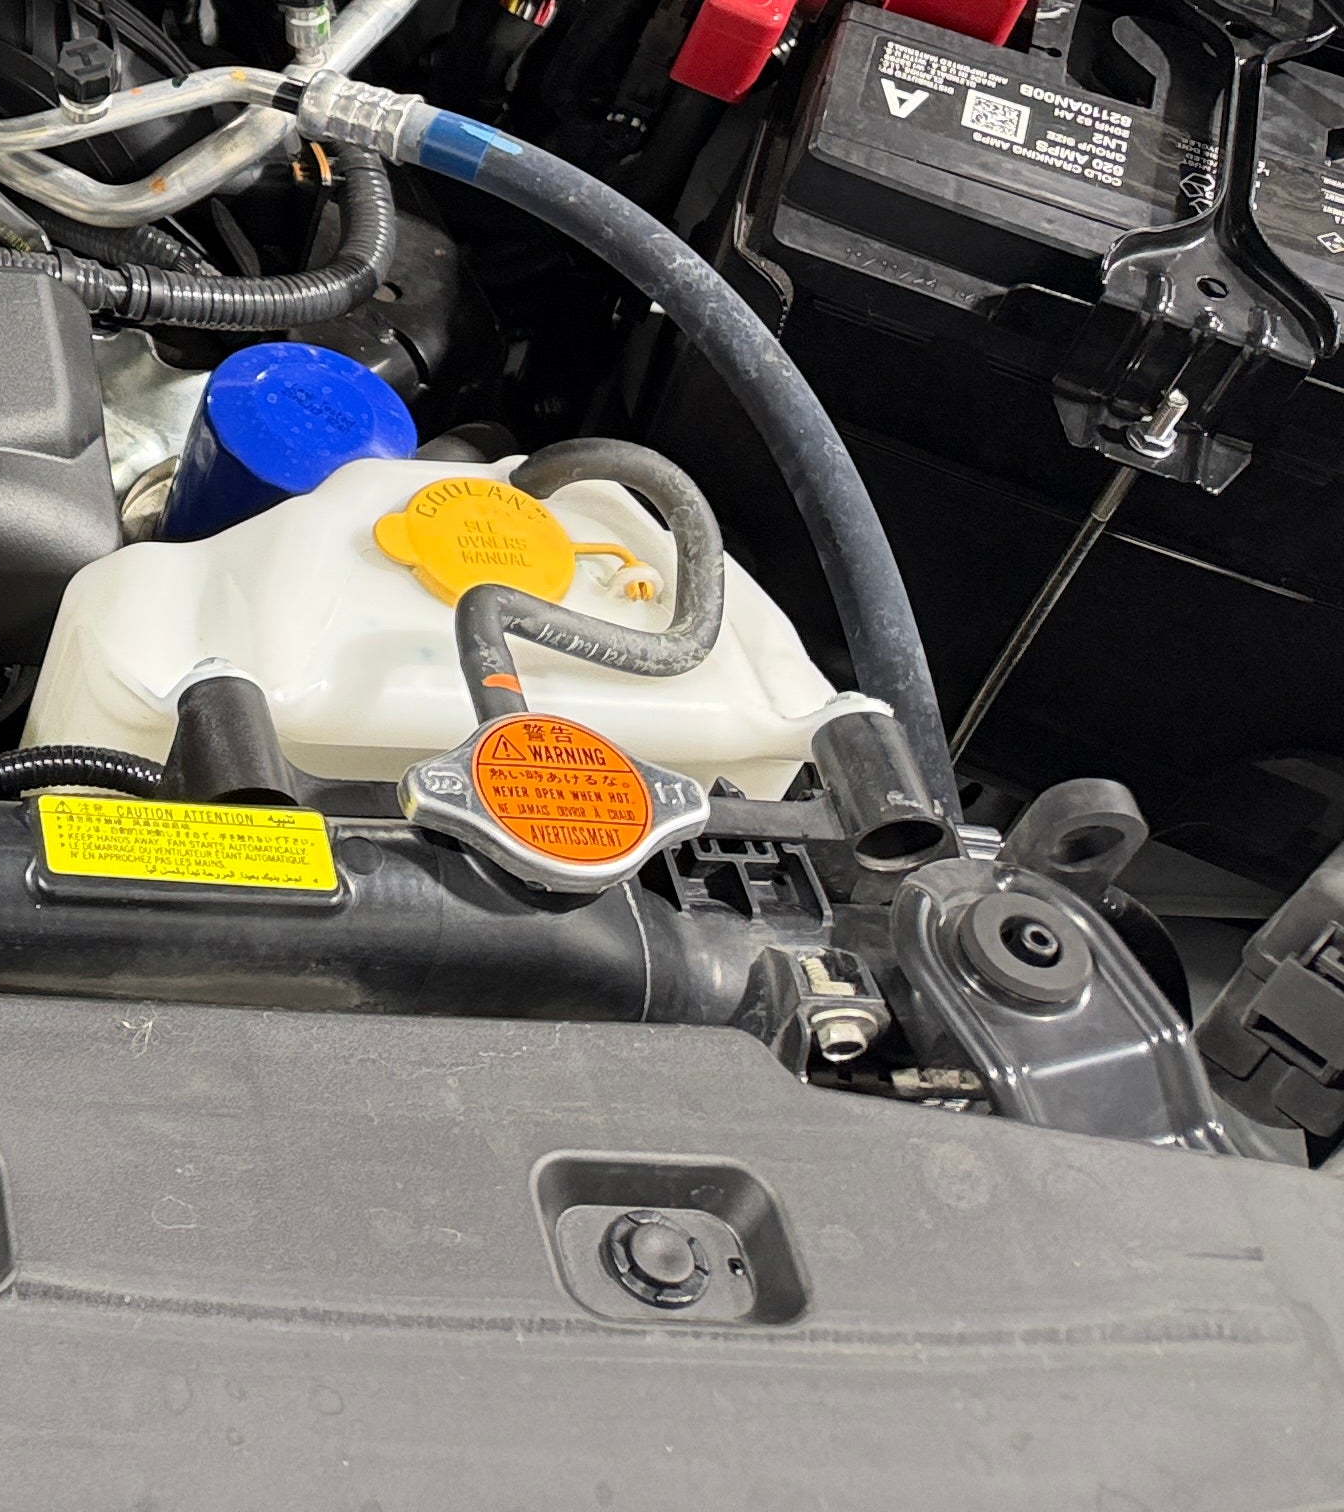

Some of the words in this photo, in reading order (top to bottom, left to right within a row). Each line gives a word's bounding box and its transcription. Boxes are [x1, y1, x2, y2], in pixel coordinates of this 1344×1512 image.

[1054, 107, 1074, 121] AH
[972, 131, 1011, 151] AMPS
[1046, 130, 1076, 147] SIZE
[1092, 132, 1128, 153] LN2
[1012, 144, 1083, 175] CRANKING
[1035, 139, 1090, 166] AMPS
[1078, 141, 1127, 163] GROUP
[1091, 158, 1125, 177] 620
[1083, 168, 1123, 187] COLD
[415, 481, 547, 520] COOLANT
[461, 550, 533, 568] MANUAL
[522, 723, 573, 744] 警告
[527, 744, 606, 766] WARNING
[492, 785, 529, 798] NEVER
[535, 788, 565, 800] OPEN
[570, 790, 603, 802] WHEN
[116, 805, 173, 820] CAUTION
[184, 809, 254, 826] ATTENTION
[498, 803, 509, 814] NE
[517, 804, 550, 816] JAMAIS
[607, 808, 636, 822] CHAUD
[68, 833, 91, 841] KEEP
[97, 834, 131, 845] HANDS
[167, 839, 186, 848] FAN
[189, 841, 225, 851] STARTS
[529, 824, 622, 848] AVERTISSMENT
[83, 851, 95, 860] EN
[98, 852, 152, 864] APPROCHEZ
[155, 857, 173, 865] PAS
[175, 857, 191, 866] LES
[139, 847, 152, 855] DU
[155, 846, 212, 859] VENTILATEUR
